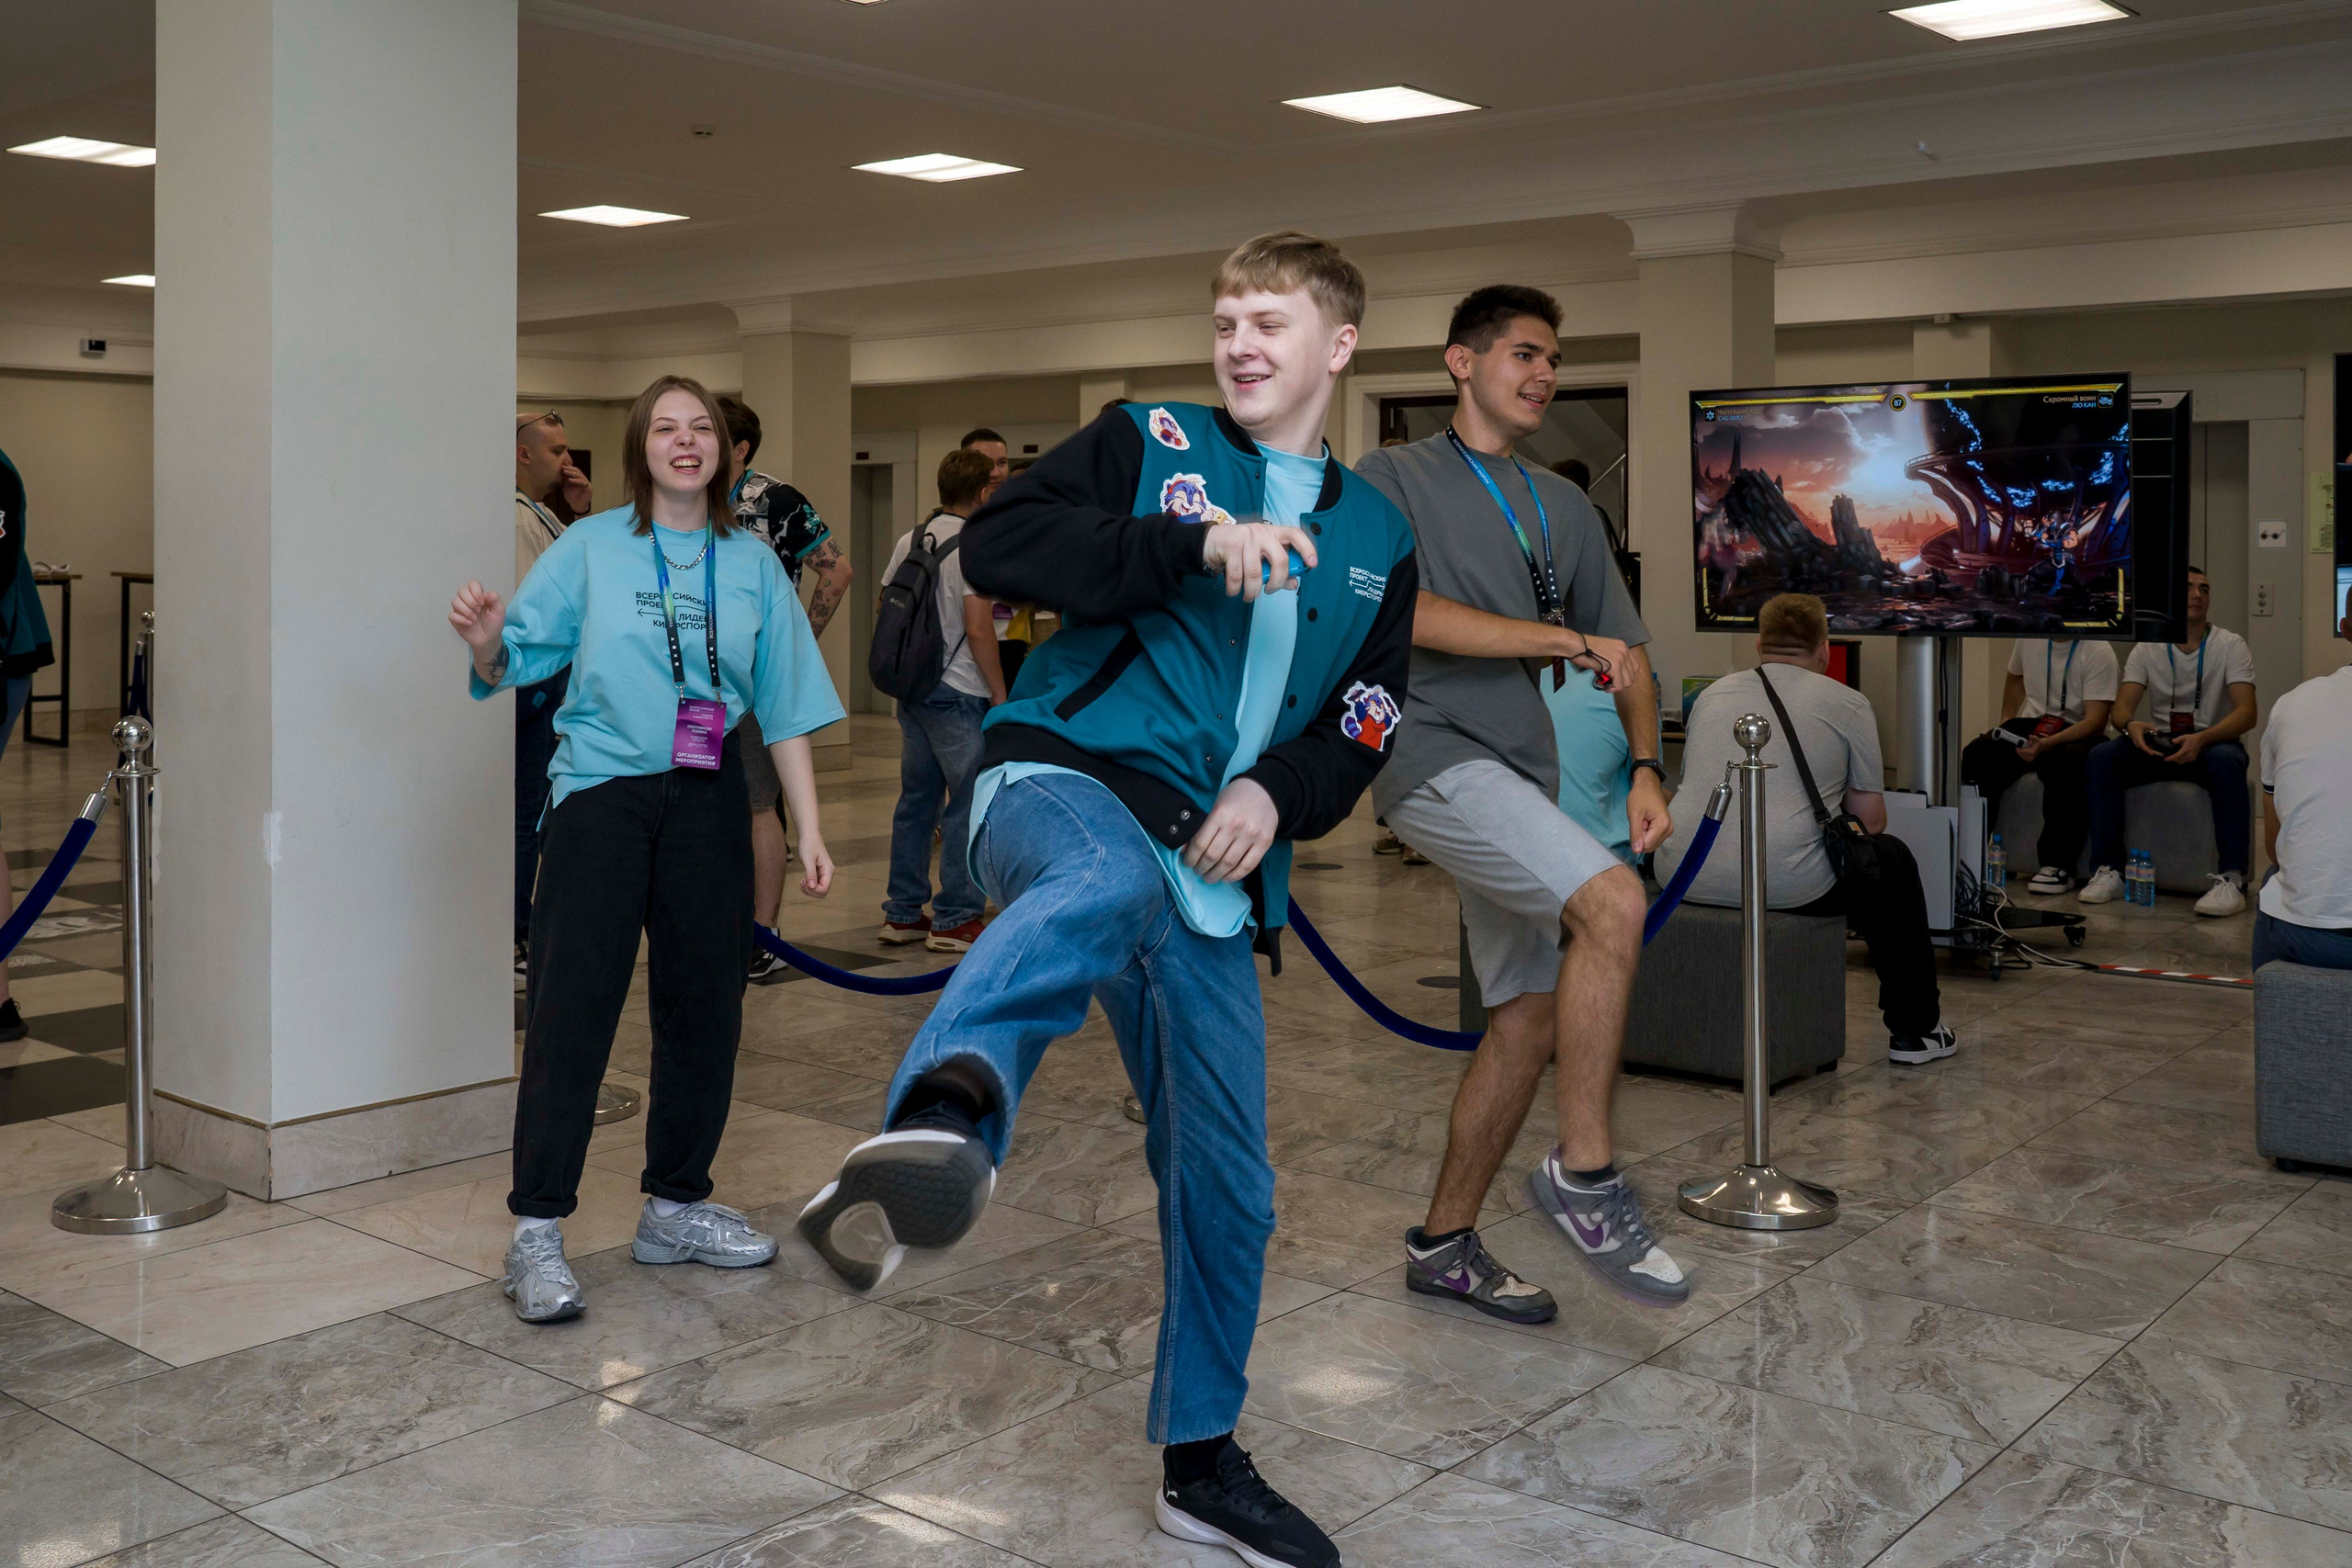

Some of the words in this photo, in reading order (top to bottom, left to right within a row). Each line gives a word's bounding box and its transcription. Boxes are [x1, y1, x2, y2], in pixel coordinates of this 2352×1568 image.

[2043, 394, 2078, 403] Скромный
[1350, 567, 1386, 582] ВСЕРОСЙСКИЙ
[636, 592, 706, 606] ВСЕРСИЙСКИ
[636, 600, 663, 608] ПРОЕ
[678, 614, 706, 622] ЛИДЕ
